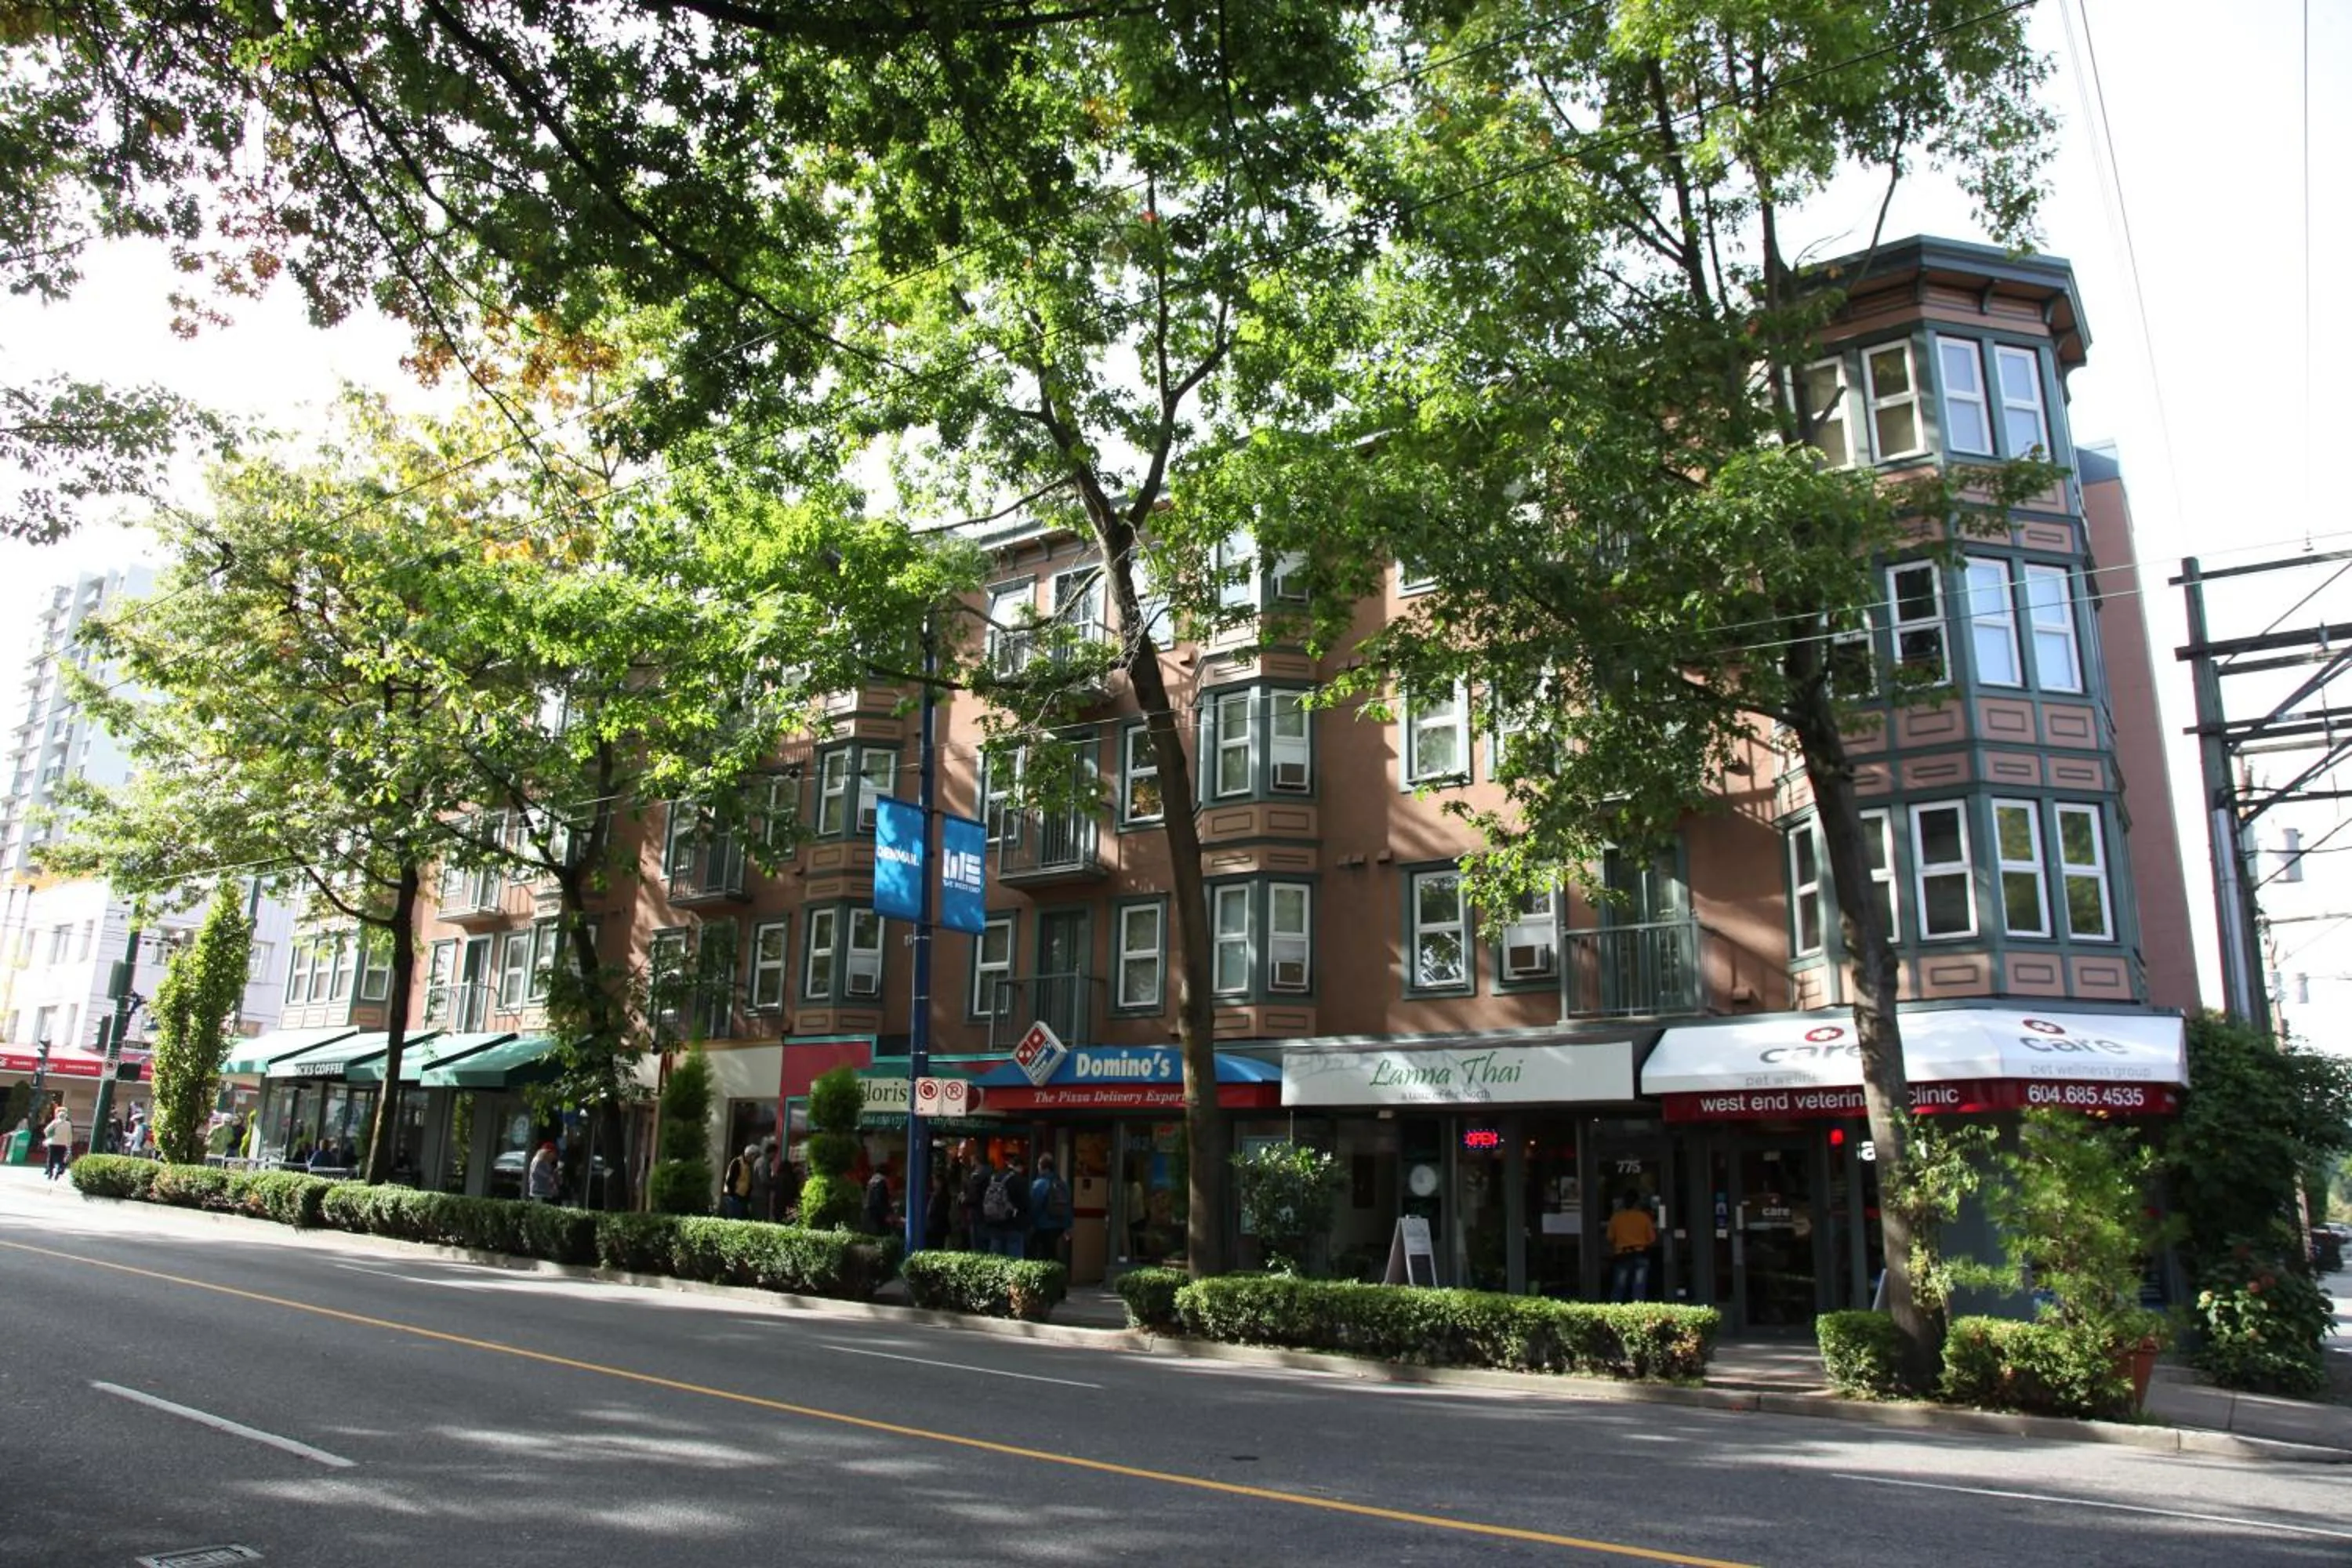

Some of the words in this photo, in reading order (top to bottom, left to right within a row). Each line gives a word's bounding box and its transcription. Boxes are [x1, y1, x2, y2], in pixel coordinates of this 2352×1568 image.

[2020, 1037, 2129, 1054] care
[314, 1062, 344, 1075] COFFEE
[1076, 1051, 1171, 1078] Domino's
[1370, 1059, 1451, 1086] Lanna
[1461, 1051, 1523, 1084] Thai
[2031, 1064, 2053, 1076] pet
[2058, 1063, 2111, 1077] wellness
[2115, 1066, 2152, 1080] group
[1745, 1073, 1770, 1087] pet
[1034, 1091, 1055, 1103] The
[1058, 1091, 1090, 1103] Pizza
[1094, 1090, 1142, 1104] Delivery
[1700, 1098, 1747, 1112] west
[1751, 1093, 1789, 1110] end
[1795, 1090, 1864, 1109] veterin
[2027, 1084, 2144, 1106] 604.685.4535
[1467, 1131, 1497, 1145] OPEN
[1617, 1160, 1642, 1174] 775
[1762, 1207, 1791, 1217] care
